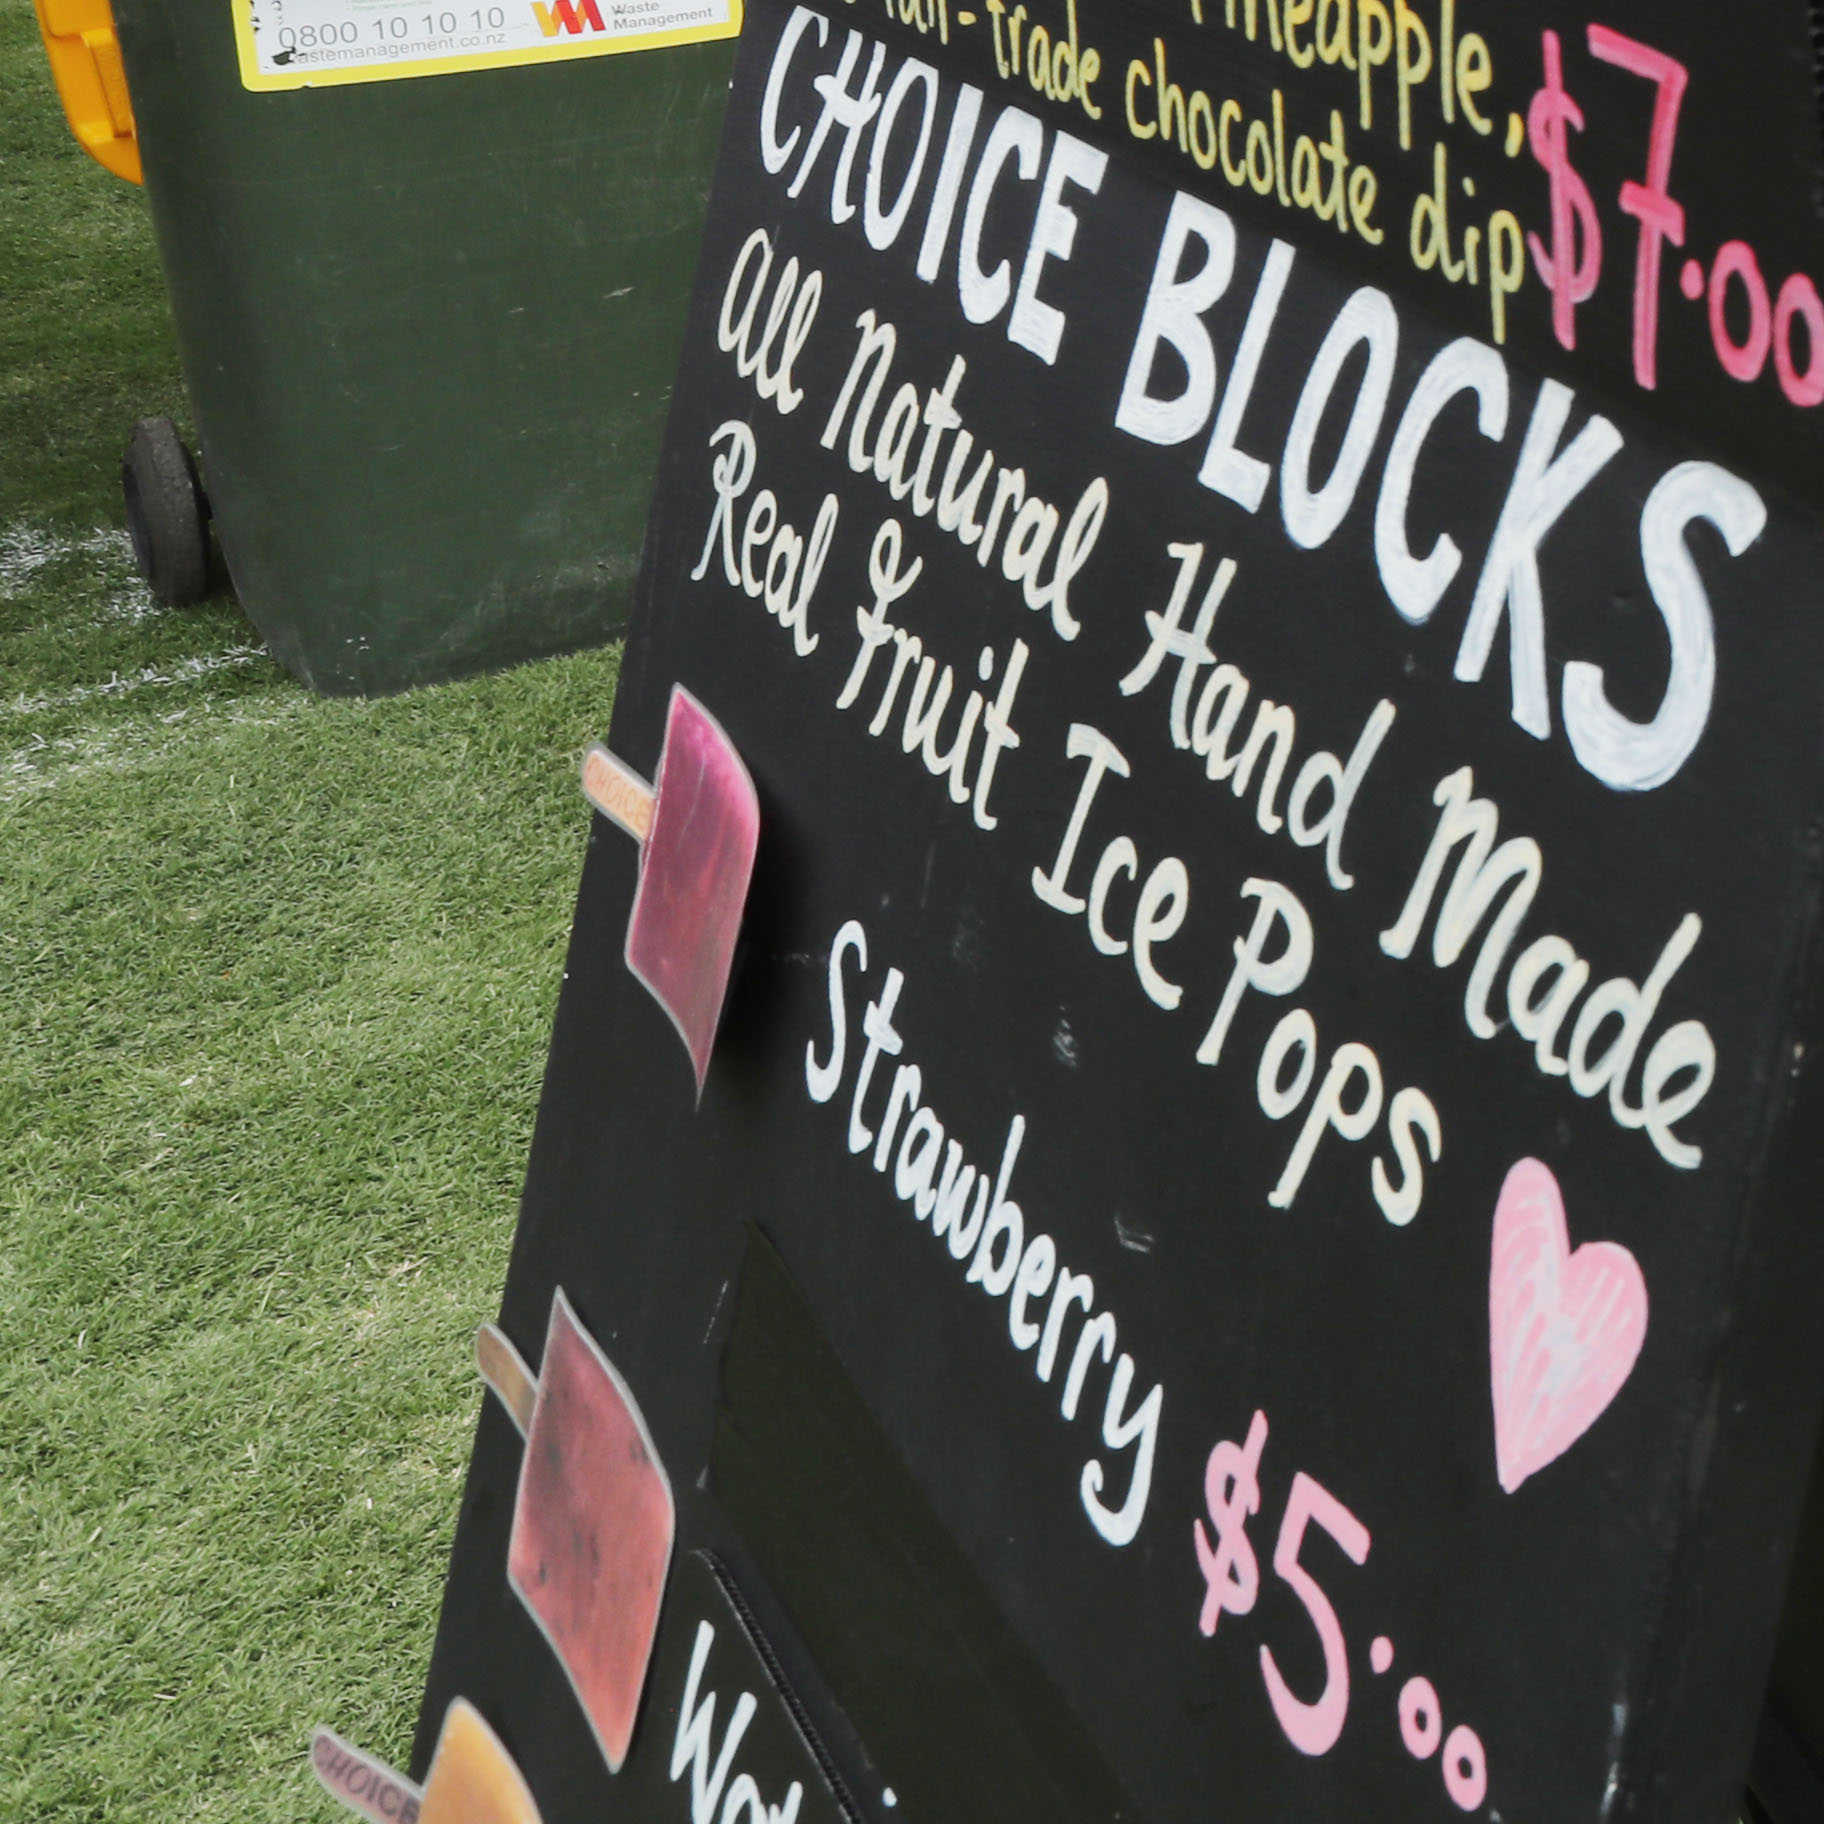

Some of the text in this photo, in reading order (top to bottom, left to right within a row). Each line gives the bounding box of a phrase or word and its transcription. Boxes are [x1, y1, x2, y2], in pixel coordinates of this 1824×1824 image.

[278, 6, 506, 51] 0800 10 10 10
[285, 34, 507, 64] astemanagement.co.nz
[613, 5, 714, 32] Management
[1125, 68, 1384, 249] chocolate
[1409, 174, 1526, 346] dip
[760, 5, 1768, 793] CHOICE BLOCKS
[691, 419, 1445, 1228] Real Fruit Ice Pops
[820, 309, 1719, 1172] Natural Hand Made
[804, 919, 1490, 1813] Strawberry $5.00
